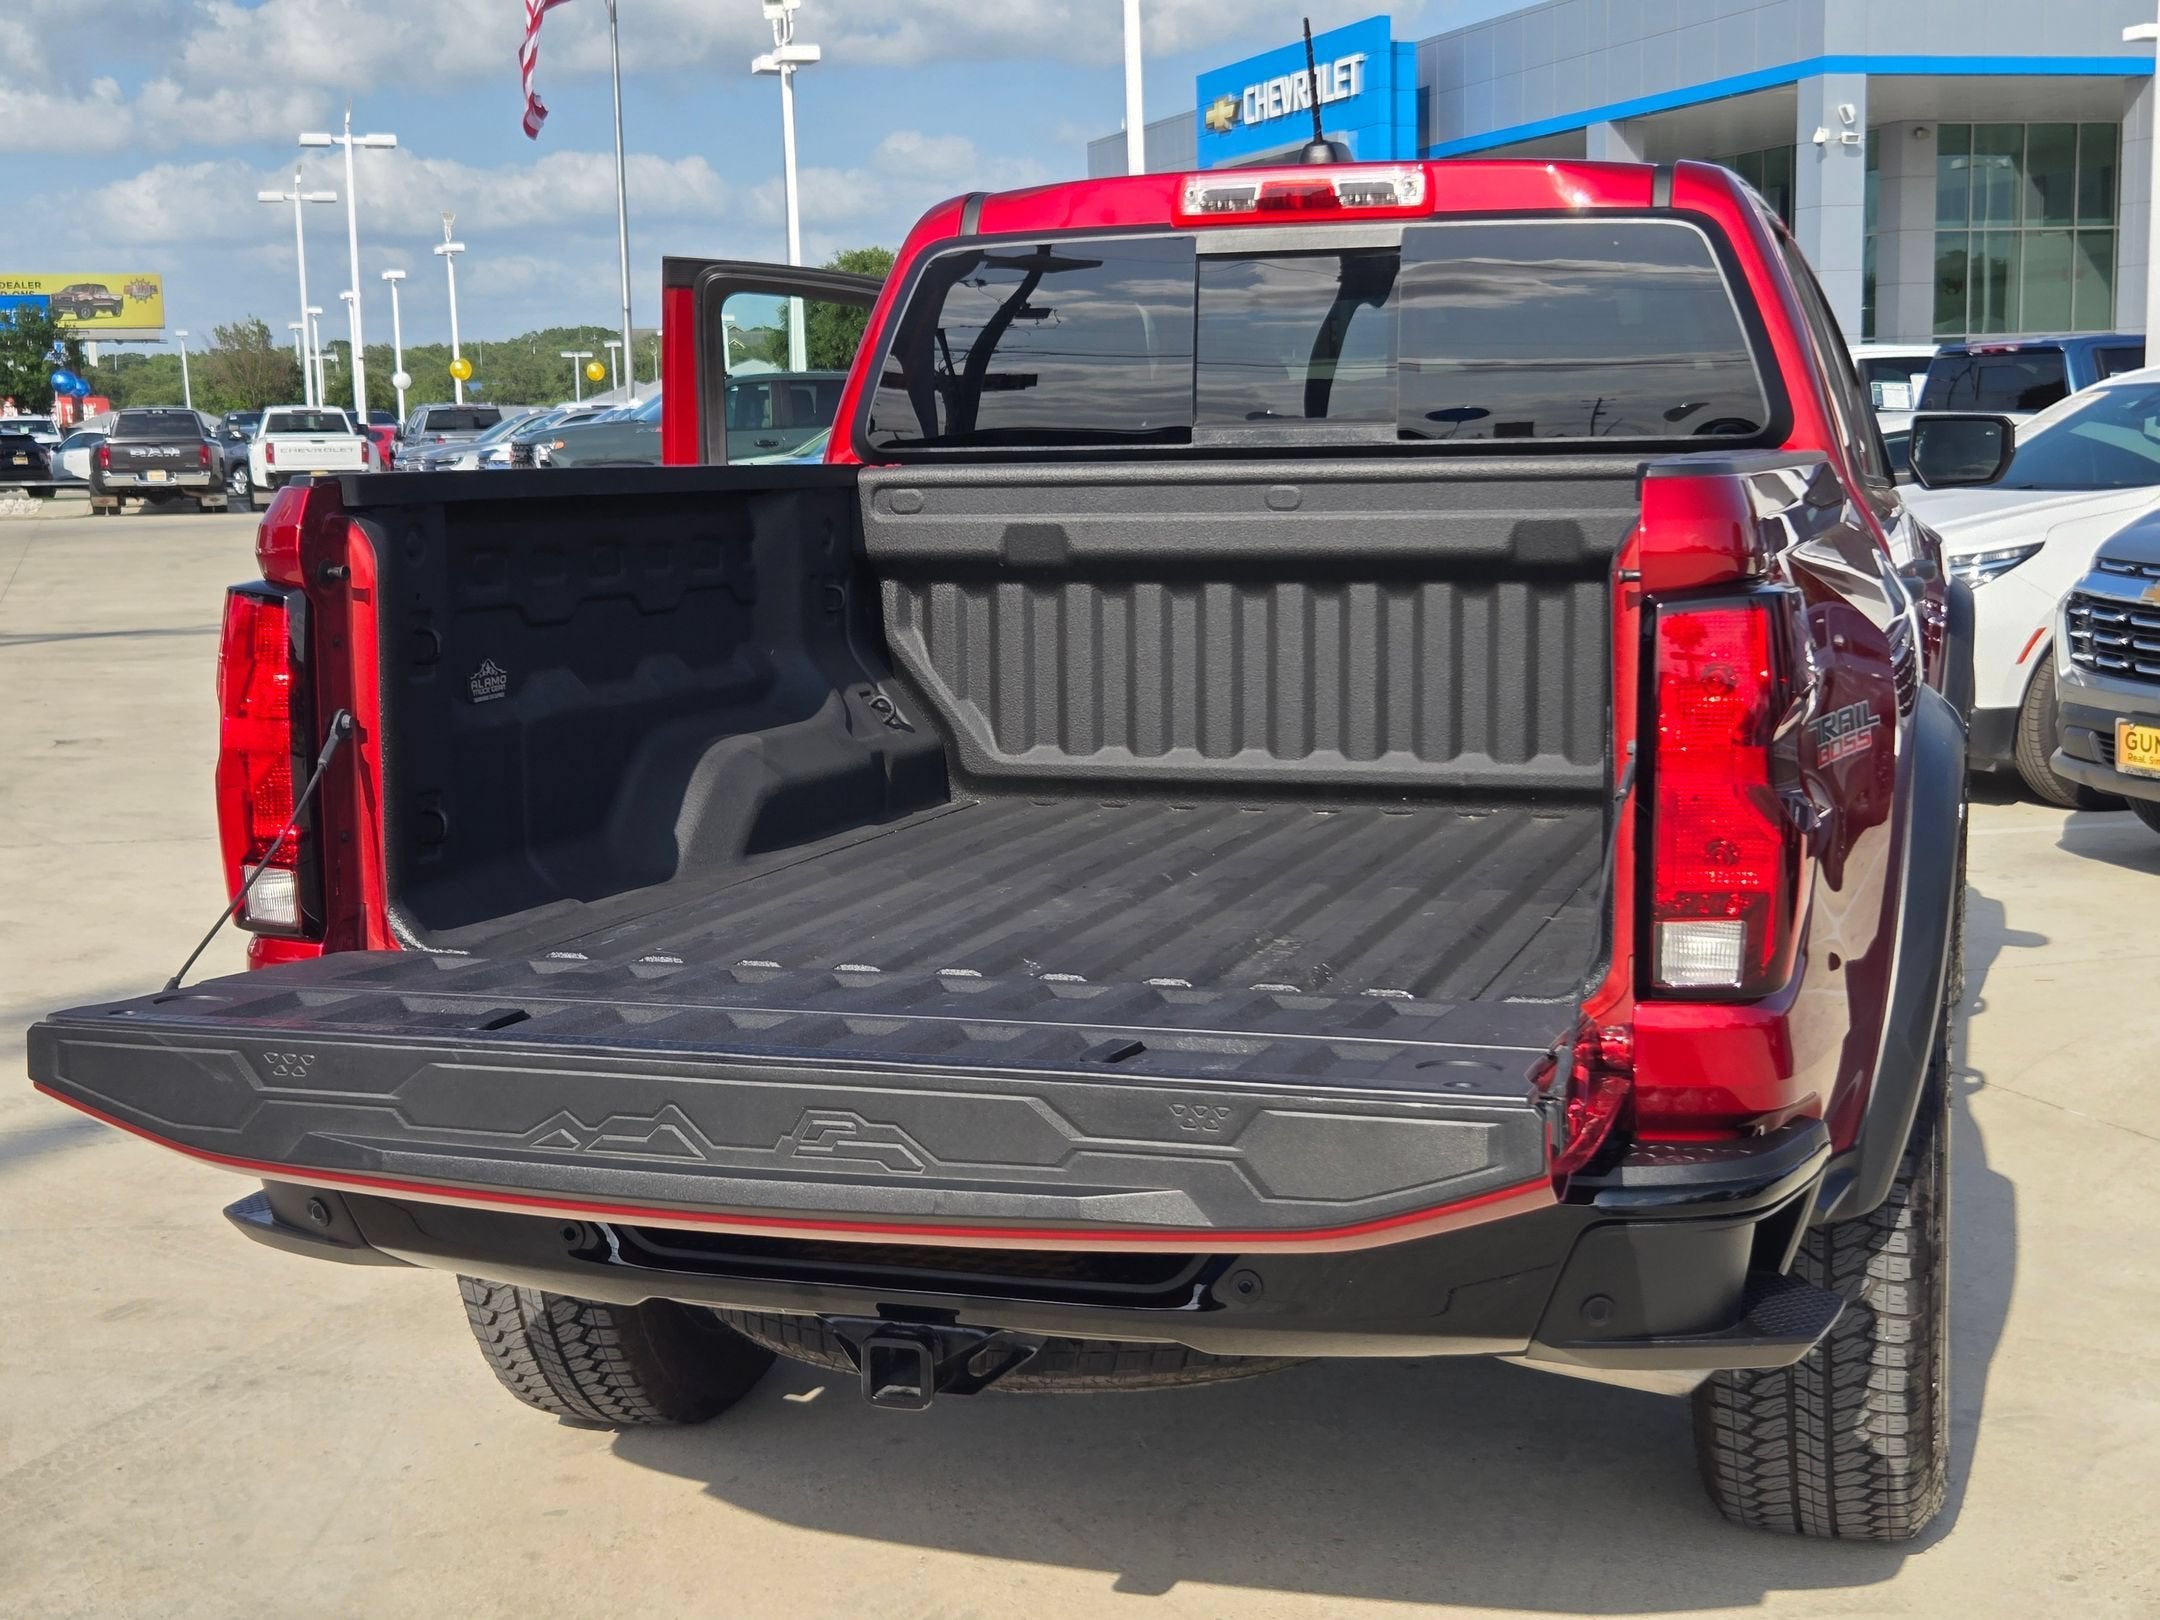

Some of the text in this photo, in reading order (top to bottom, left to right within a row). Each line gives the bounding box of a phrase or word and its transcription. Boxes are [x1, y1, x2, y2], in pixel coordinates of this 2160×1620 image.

[0, 281, 42, 289] DEALER
[129, 447, 181, 457] RAM
[471, 675, 507, 690] ALAMO
[1808, 700, 1881, 748] TRAIL
[1817, 727, 1872, 770] BOSS
